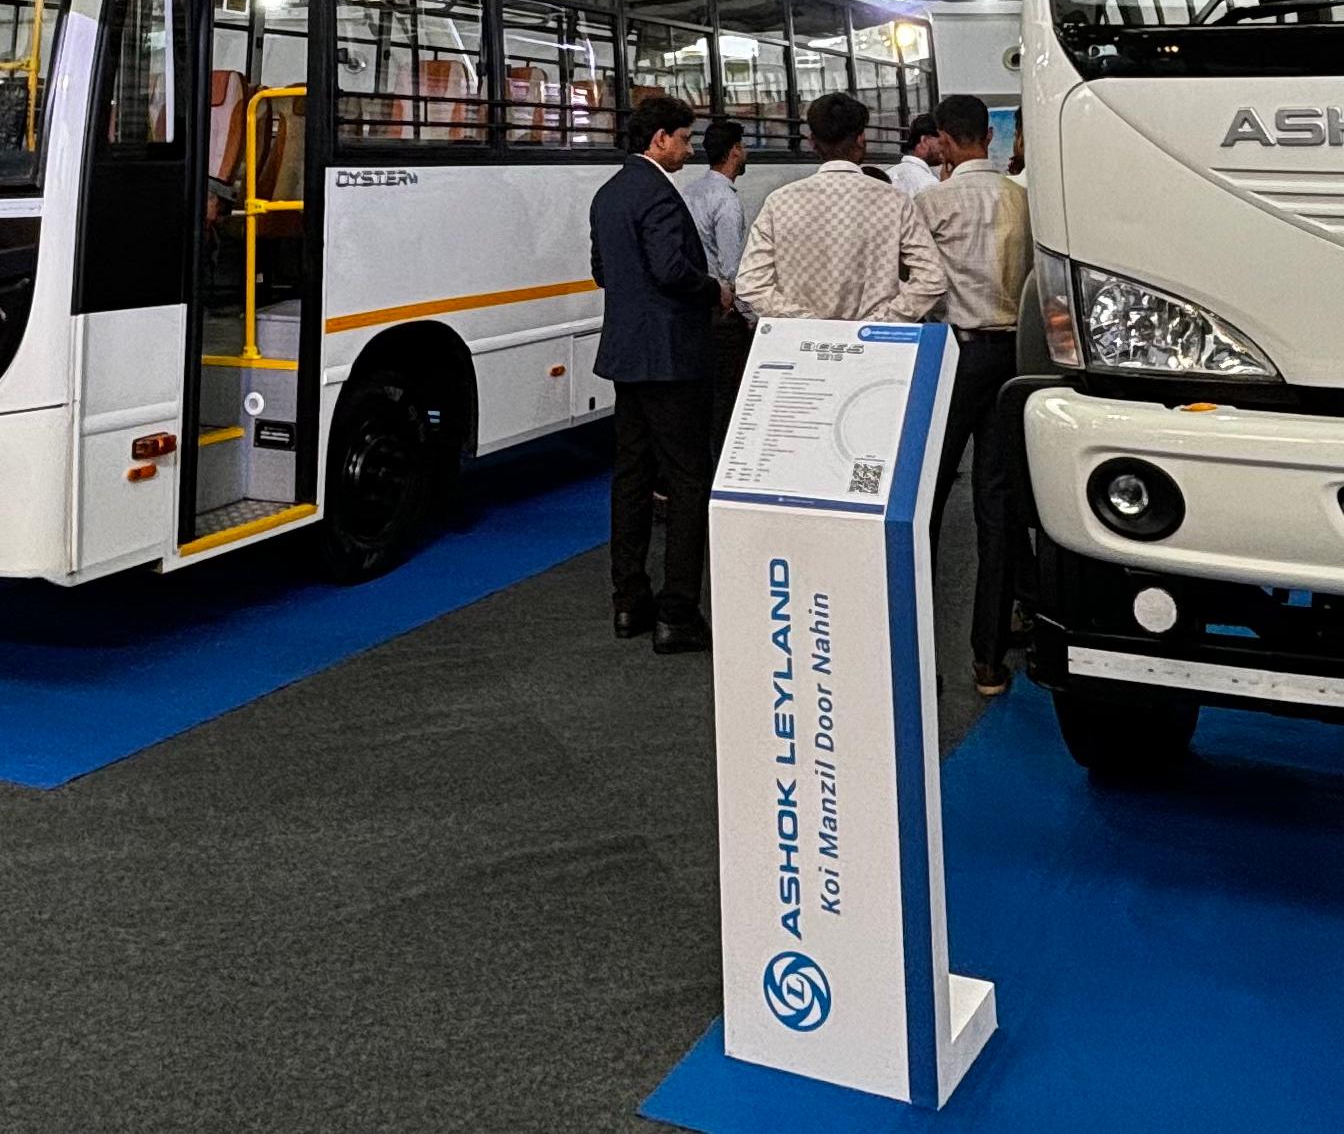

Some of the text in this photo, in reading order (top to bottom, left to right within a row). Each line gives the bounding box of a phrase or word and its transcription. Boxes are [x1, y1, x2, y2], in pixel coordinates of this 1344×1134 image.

[335, 169, 407, 186] OYSTER
[768, 557, 803, 942] ASHOK LEYLAND
[807, 592, 841, 915] Koi Manzil Door Nahin
